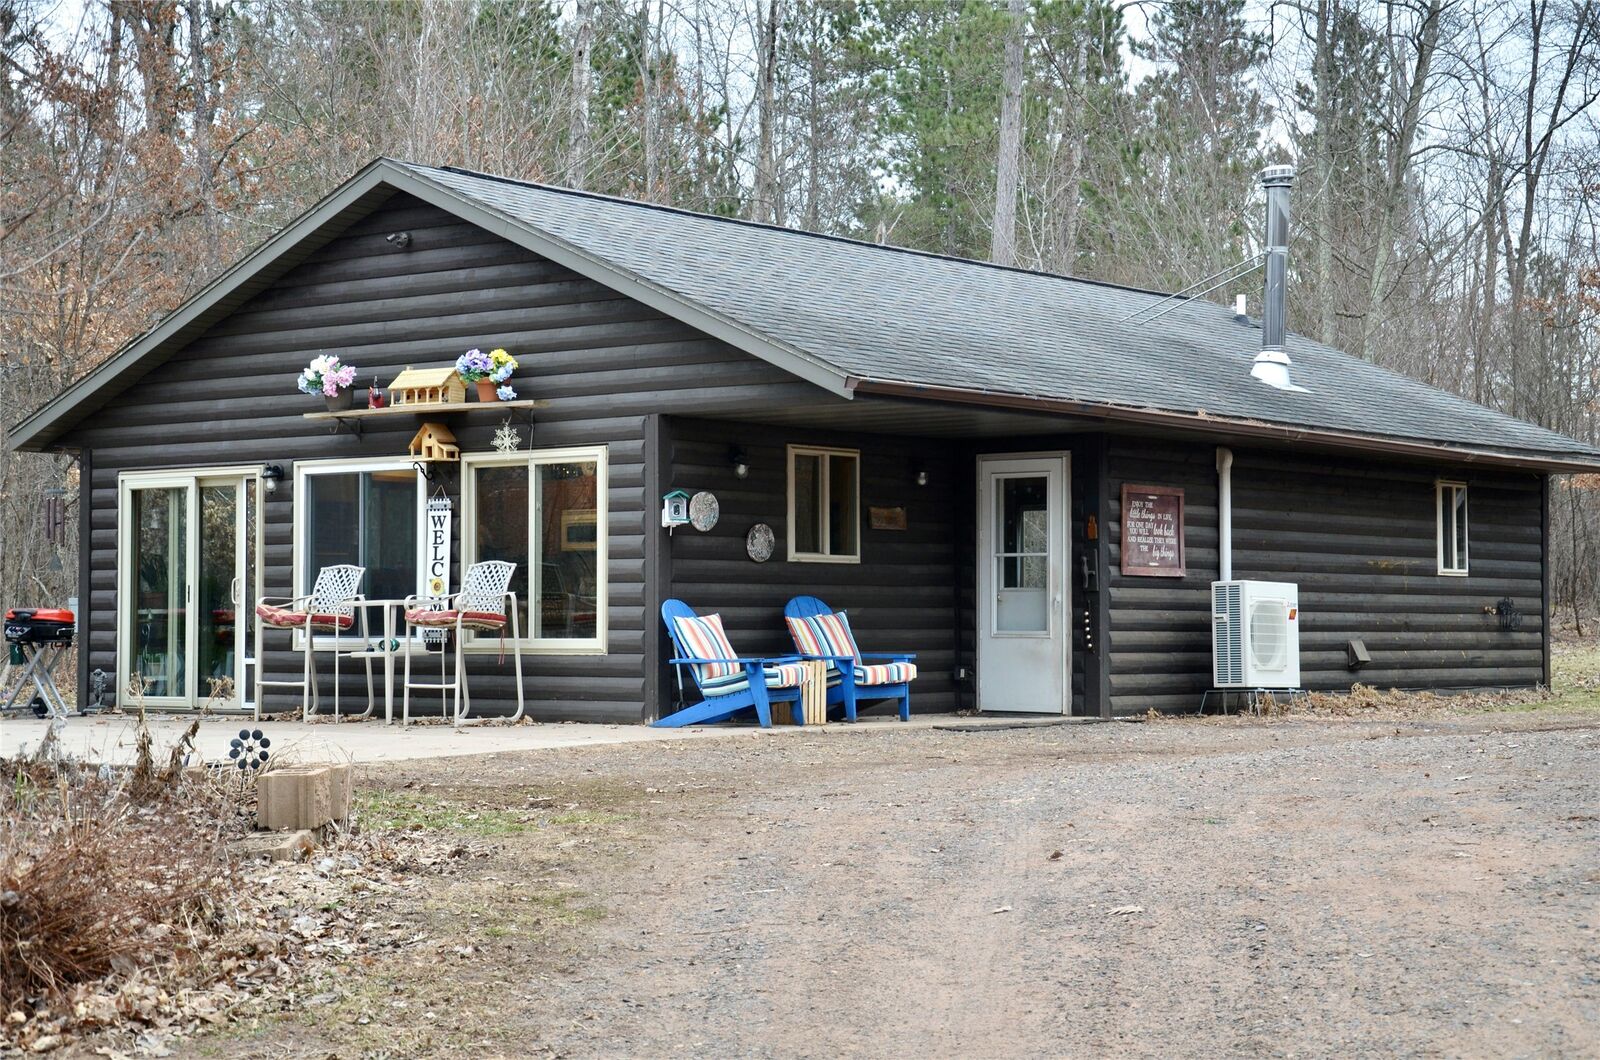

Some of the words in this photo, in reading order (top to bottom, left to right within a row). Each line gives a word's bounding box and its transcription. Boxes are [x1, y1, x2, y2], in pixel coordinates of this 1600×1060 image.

[1141, 509, 1156, 521] things
[1160, 545, 1175, 560] things
[431, 515, 447, 611] WELCM
